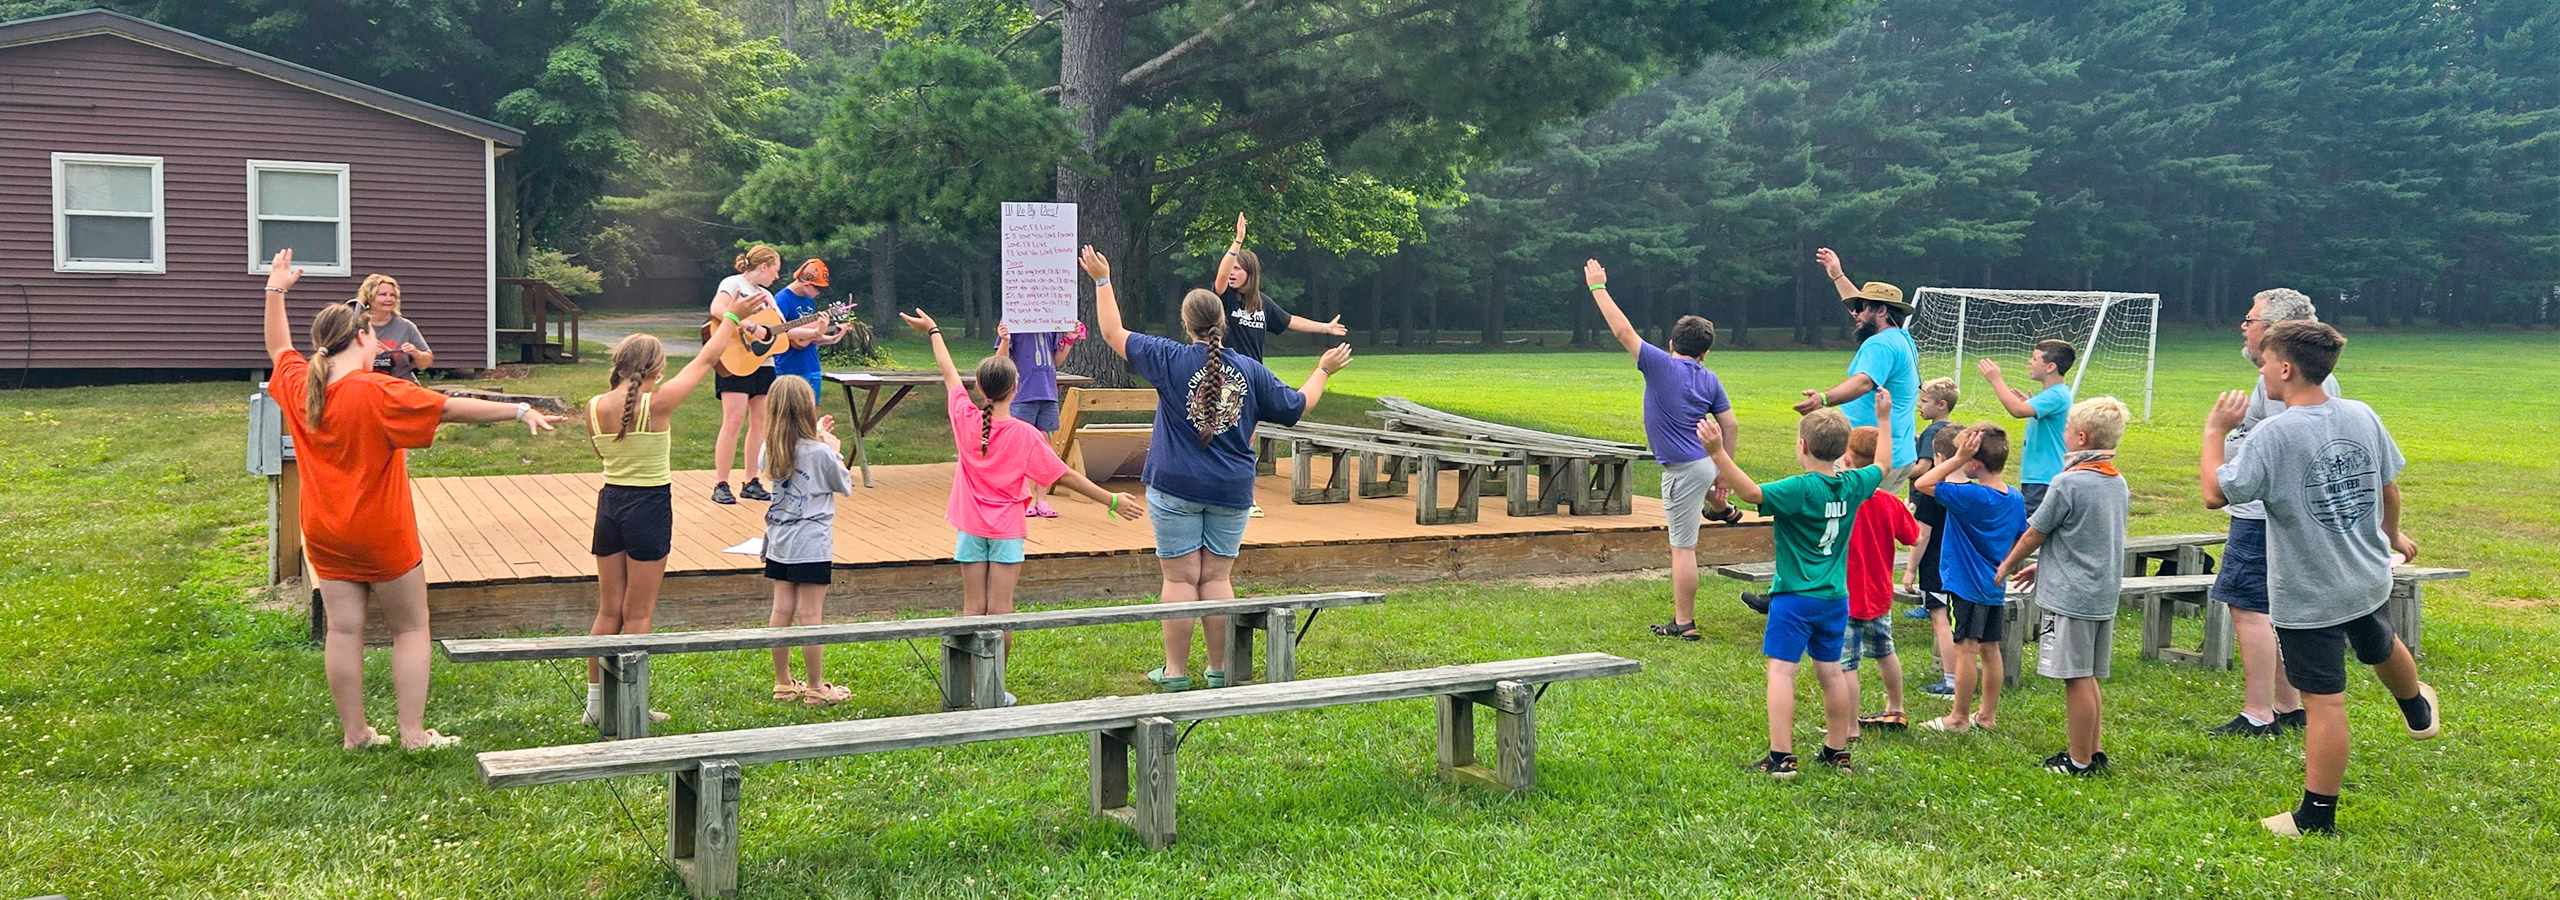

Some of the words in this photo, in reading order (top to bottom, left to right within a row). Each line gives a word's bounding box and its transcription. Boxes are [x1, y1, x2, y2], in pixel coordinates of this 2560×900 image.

[1016, 204, 1025, 216] Do
[1040, 204, 1059, 217] Best
[1238, 318, 1264, 329] SOCCER
[1219, 364, 1248, 396] APLETON
[1818, 518, 1840, 556] 4
